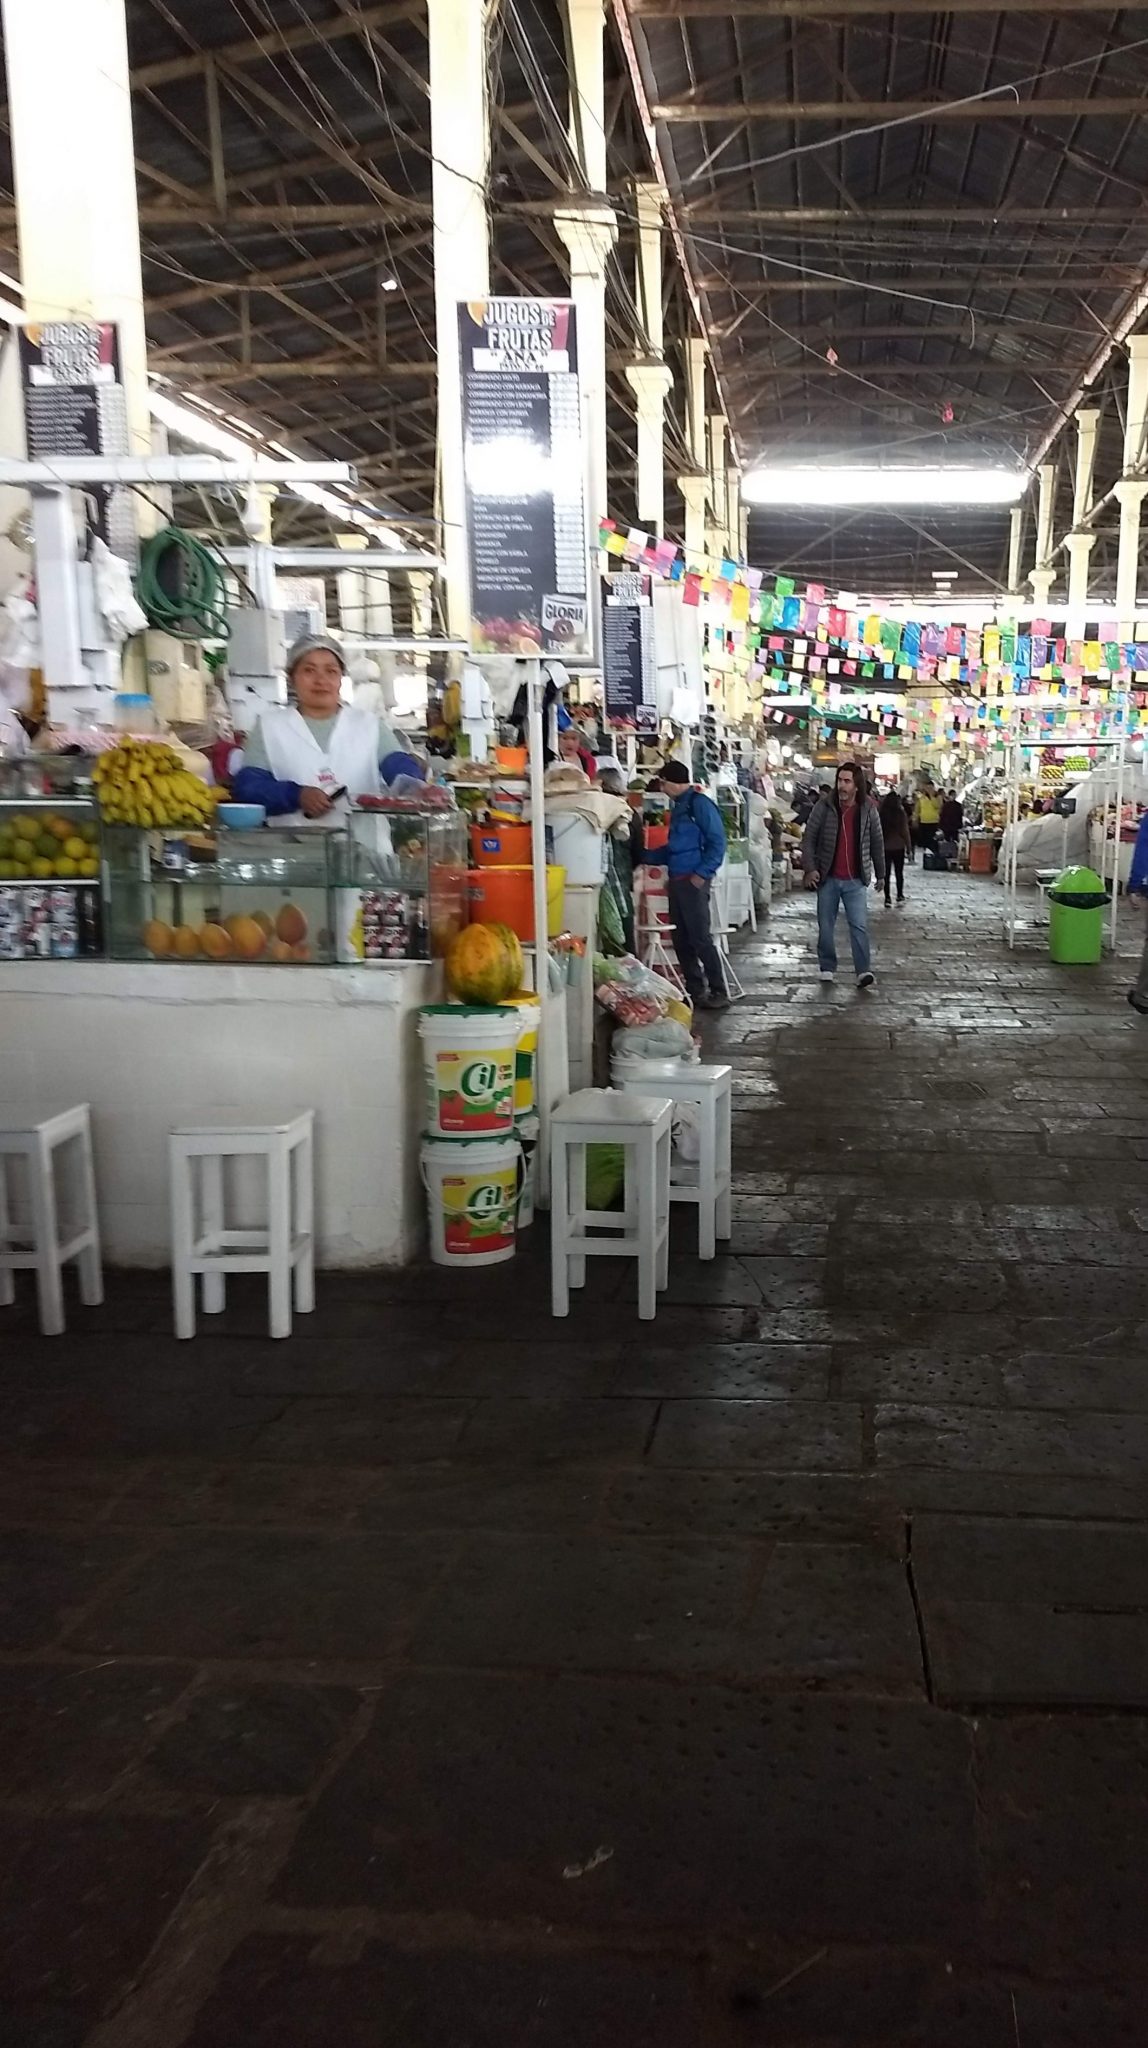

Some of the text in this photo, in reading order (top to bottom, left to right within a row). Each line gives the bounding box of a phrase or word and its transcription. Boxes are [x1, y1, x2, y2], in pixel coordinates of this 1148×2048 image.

[483, 302, 556, 326] JUGOS DE
[488, 327, 553, 350] FRUTAS
[545, 604, 584, 622] GLORIA
